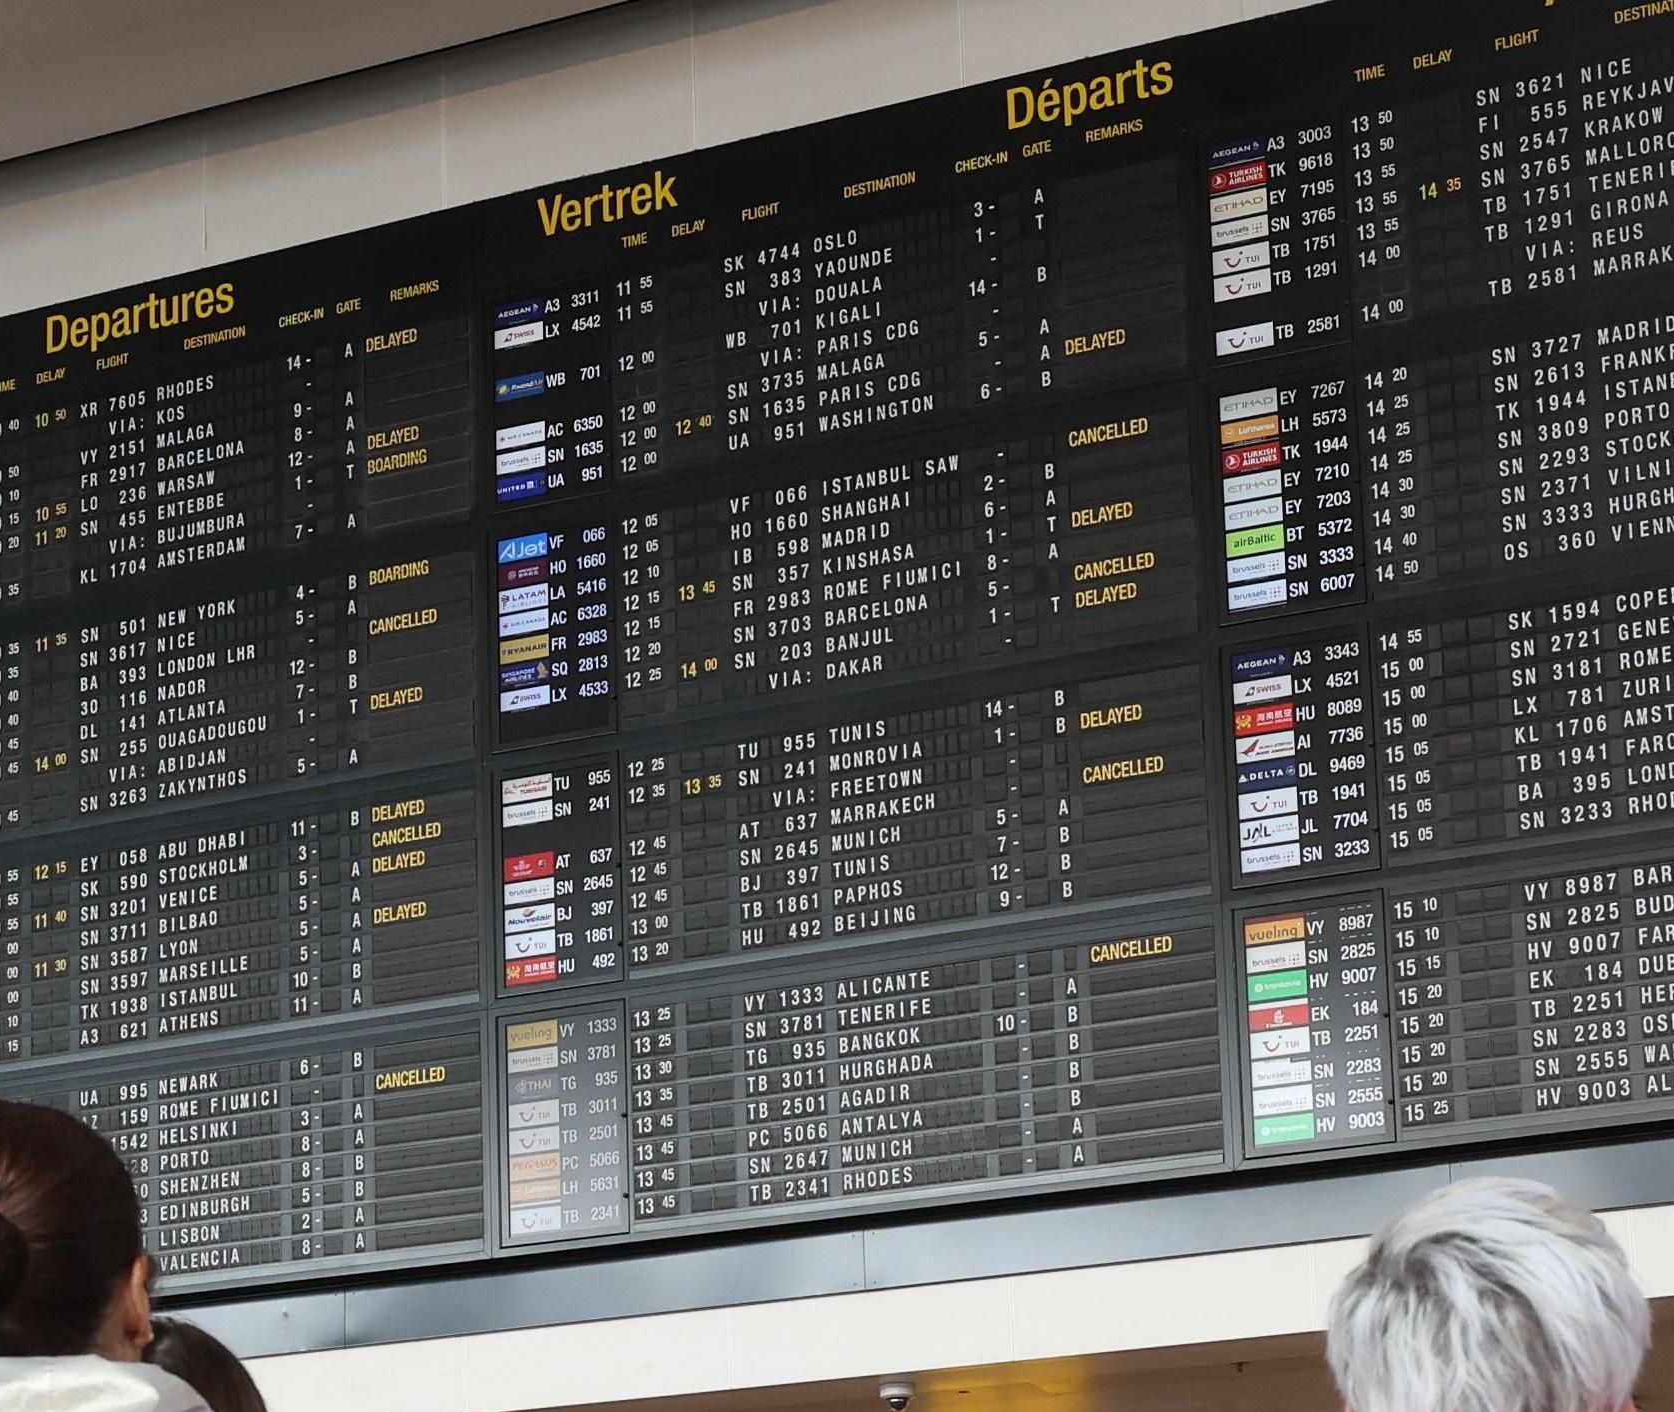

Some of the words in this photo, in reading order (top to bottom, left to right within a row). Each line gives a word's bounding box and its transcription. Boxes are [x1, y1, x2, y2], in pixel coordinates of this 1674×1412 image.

[1353, 63, 1386, 82] TIME
[1412, 48, 1453, 70] DELAY
[1494, 28, 1539, 51] FLIGHT
[1006, 58, 1174, 130] Départs
[1476, 86, 1500, 107] SN
[1515, 72, 1563, 98] 3621
[1580, 57, 1632, 84] NICE
[1212, 144, 1252, 158] AEGEAN
[1481, 167, 1505, 188] SN
[1520, 154, 1571, 180] 3765
[537, 170, 678, 236] Vertrek
[620, 231, 648, 249] TIME
[671, 218, 706, 238] DELAY
[741, 201, 780, 222] FLIGHT
[843, 170, 916, 199] DESTINATION
[954, 150, 1008, 174] CHECK-IN
[1022, 139, 1052, 158] GATE
[1085, 118, 1144, 144] REMARKS
[1590, 189, 1669, 221] GIRONA
[724, 254, 744, 273] SK
[757, 242, 800, 265] 4744
[813, 229, 857, 253] OSLO
[814, 247, 893, 279] YAOUNDE
[1245, 253, 1261, 263] TUI
[36, 367, 66, 385] DELAY
[96, 352, 129, 371] FLIGHT
[183, 325, 246, 351] DESTINATION
[278, 307, 324, 328] CHECK-IN
[335, 297, 361, 315] GATE
[390, 279, 440, 302] REMARKS
[46, 282, 235, 354] Departures
[817, 329, 872, 356] PARIS
[886, 319, 919, 341] CDG
[80, 401, 98, 419] XR
[108, 390, 146, 412] 7605
[156, 374, 214, 402] RHODES
[365, 327, 418, 353] DELAYED
[818, 380, 874, 407] PARIS
[887, 371, 921, 392] CDG
[1064, 328, 1126, 356] DELAYED
[156, 405, 185, 425] KOS
[818, 394, 934, 433] WASHINGTON
[157, 440, 244, 473] BARCELONA
[157, 470, 215, 497] WARSAW
[367, 425, 419, 450] DELAYED
[729, 495, 750, 514] VF
[775, 485, 807, 506] 066
[823, 464, 911, 496] ISTANBUL
[925, 454, 959, 476] SAW
[1068, 417, 1148, 448] CANCELLED
[157, 492, 224, 521] ENTEBBE
[367, 448, 428, 475] BOARDING
[821, 491, 910, 523] SHANGHAI
[157, 512, 245, 545] BUJUMBURA
[822, 543, 915, 575] KINSHASA
[1071, 501, 1133, 528] DELAYED
[1233, 532, 1276, 548] airBaltic
[80, 626, 99, 644] SN
[119, 617, 145, 636] 501
[157, 608, 187, 629] NEW
[197, 599, 236, 620] YORK
[369, 559, 429, 586] BOARDING
[511, 589, 547, 602] LATAM
[824, 593, 928, 627] BARCELONA
[1074, 551, 1155, 581] CANCELLED
[1508, 610, 1533, 631] SK
[1549, 599, 1600, 624] 1594
[158, 651, 216, 677] LONDON
[227, 644, 255, 664] LHR
[369, 608, 438, 636] CANCELLED
[734, 651, 755, 670] SN
[780, 640, 812, 662] 203
[825, 627, 894, 654] BANJUL
[1075, 582, 1137, 609] DELAYED
[158, 715, 267, 750] OUAGADOUGOU
[370, 686, 423, 710] DELAYED
[829, 741, 922, 772] MONROVIA
[1080, 703, 1143, 729] DELAYED
[158, 768, 247, 799] ZAKYNTHOS
[830, 768, 922, 799] FREETOWN
[830, 792, 935, 825] MARRAKECH
[1082, 755, 1164, 784] CANCELLED
[1249, 767, 1284, 781] DELTA
[80, 855, 99, 873] EY
[119, 847, 148, 867] 058
[158, 840, 187, 860] ABU
[198, 830, 245, 853] DHABI
[371, 799, 425, 823] DELAYED
[80, 880, 99, 898] SK
[120, 872, 148, 891] 590
[159, 855, 248, 885] STOCKHOLM
[372, 821, 442, 848] CANCELLED
[158, 885, 217, 909] VENICE
[372, 850, 426, 874] DELAYED
[834, 879, 903, 906] PAPHOS
[1524, 881, 1549, 902] VY
[1565, 872, 1617, 897] 8987
[159, 938, 198, 959] LYON
[373, 901, 427, 924] DELAYED
[159, 955, 248, 984] MARSEILLE
[744, 993, 766, 1012] VY
[779, 986, 824, 1007] 1333
[837, 970, 930, 1000] ALICANTE
[1090, 935, 1172, 963] CANCELLED
[510, 1028, 552, 1042] vueling
[839, 1053, 934, 1081] HURGHADA
[159, 1100, 198, 1121] ROME
[210, 1088, 278, 1114] FIUMICI
[375, 1066, 446, 1090] CANCELLED
[160, 1224, 220, 1247] LISBON
